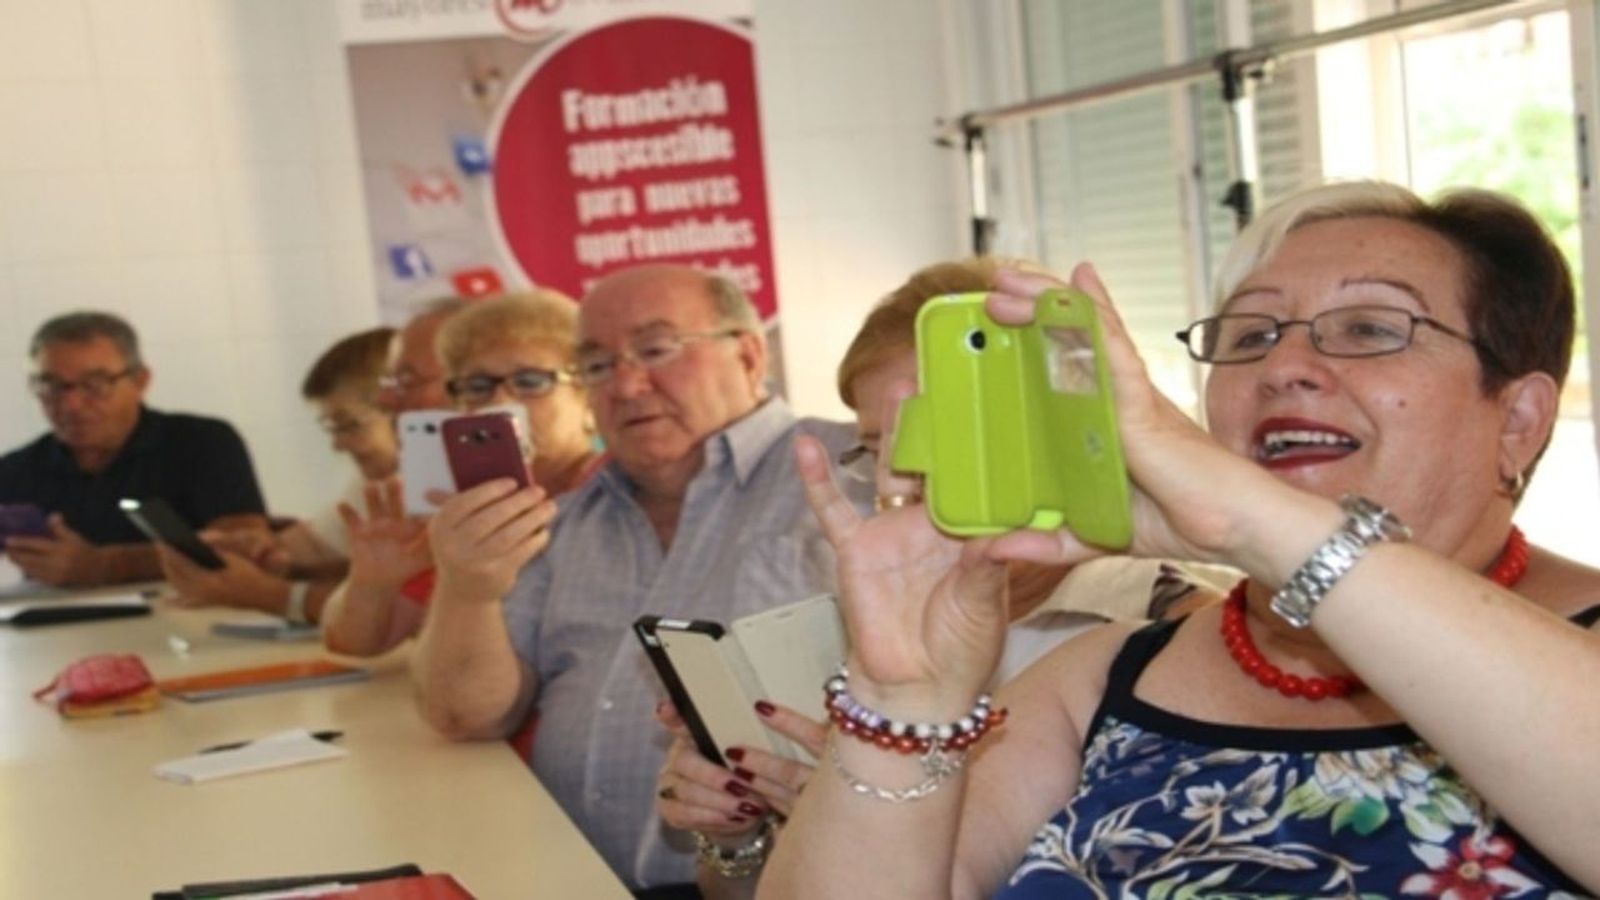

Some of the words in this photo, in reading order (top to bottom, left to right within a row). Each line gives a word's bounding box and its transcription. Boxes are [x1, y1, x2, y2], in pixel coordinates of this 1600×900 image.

[562, 76, 728, 132] Formación
[576, 187, 636, 224] para
[643, 174, 741, 214] nuevas
[575, 215, 756, 267] oportunidades
